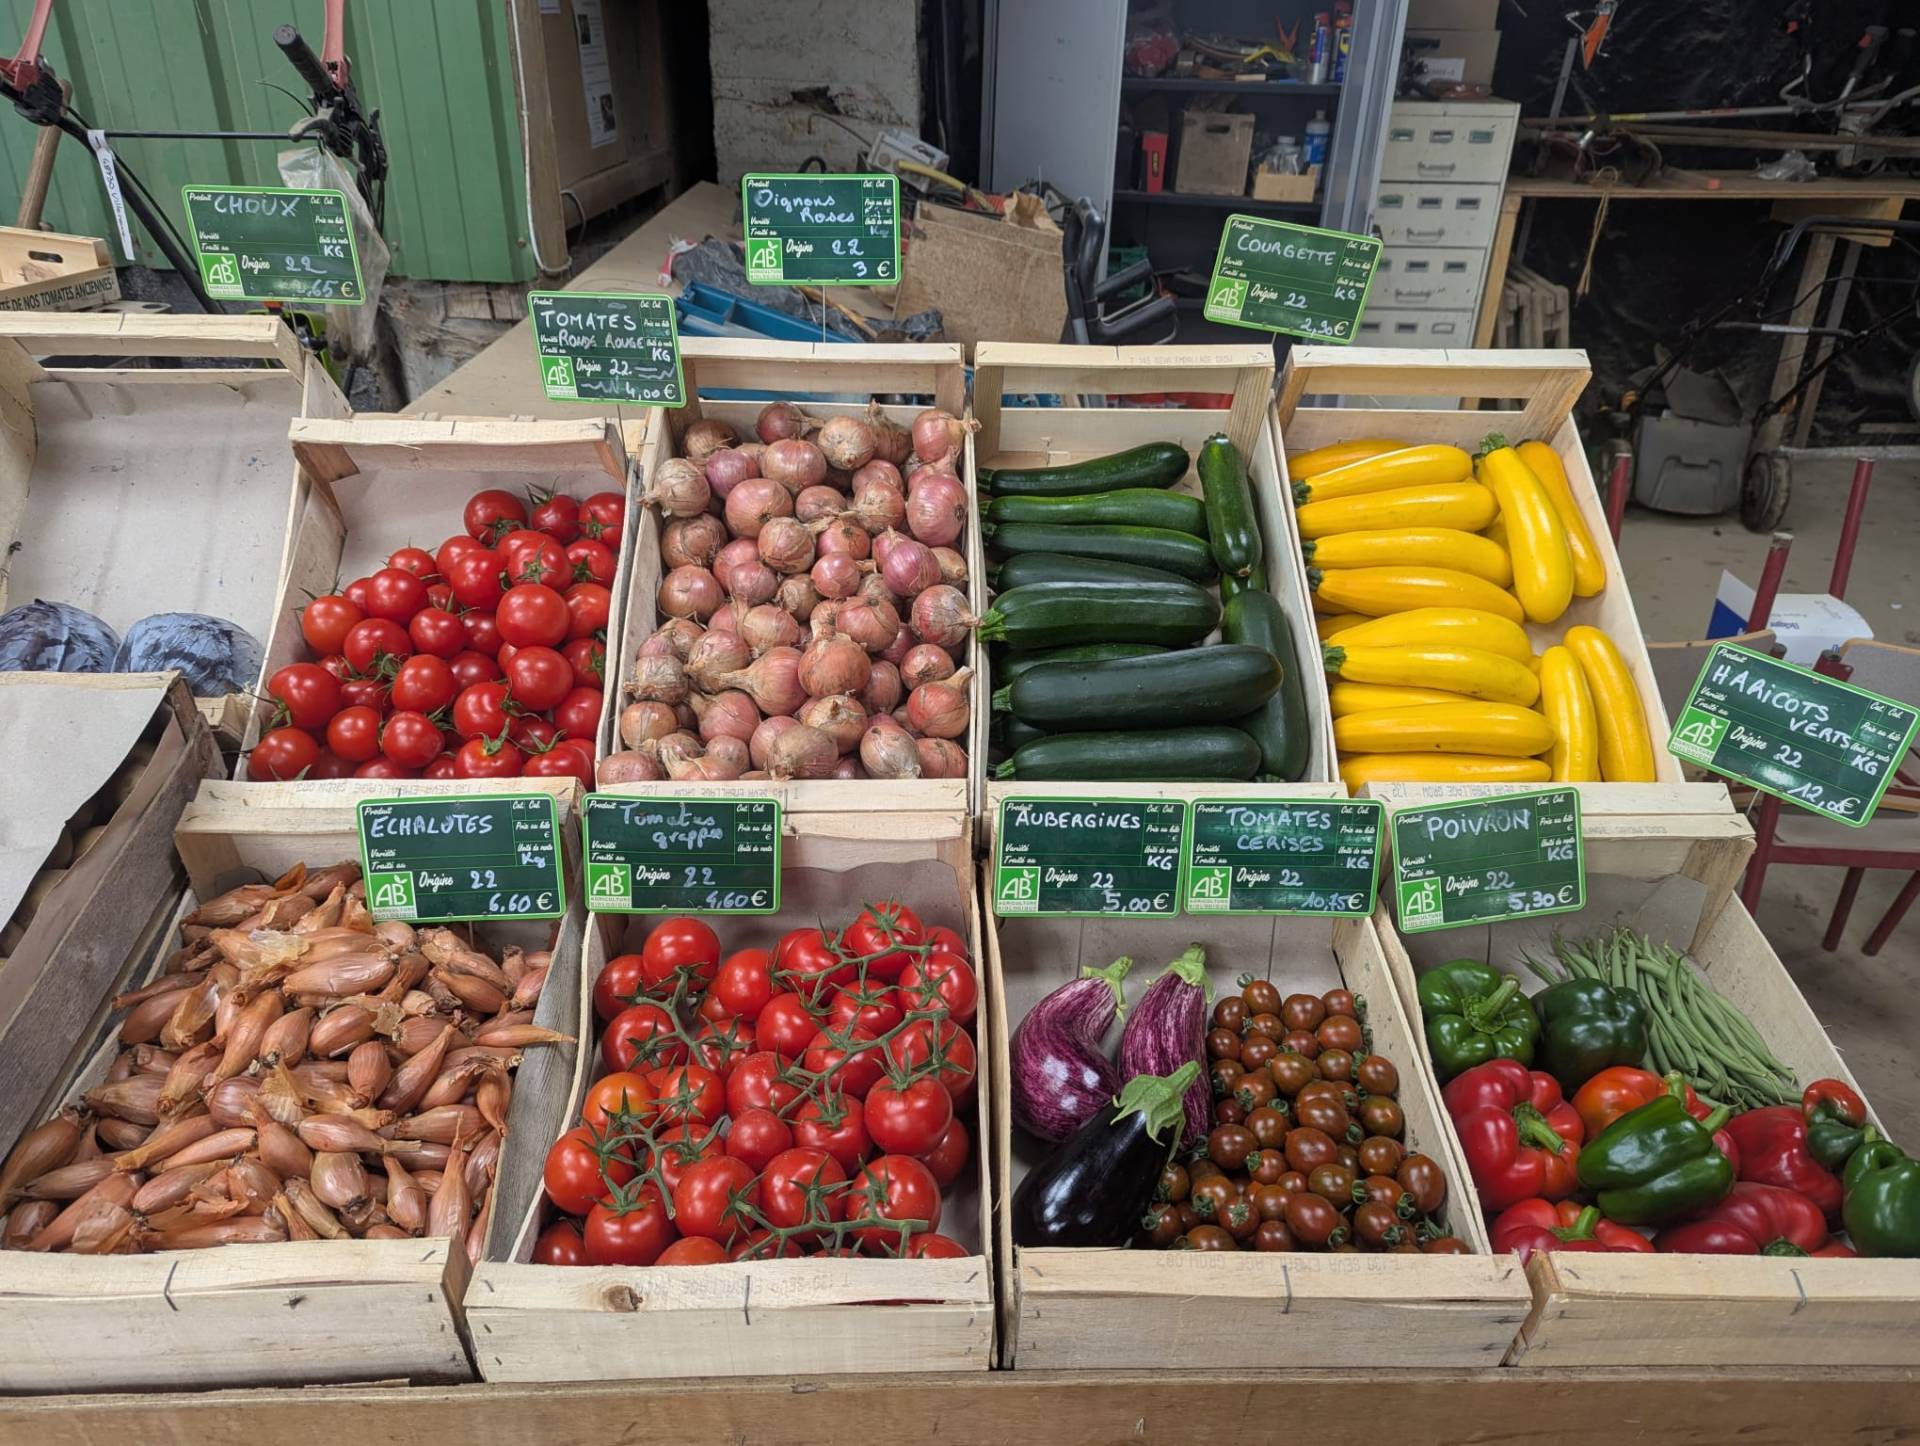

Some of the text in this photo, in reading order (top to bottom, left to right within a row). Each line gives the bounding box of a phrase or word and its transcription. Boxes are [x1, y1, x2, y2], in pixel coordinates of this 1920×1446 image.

[214, 195, 299, 217] CHOUX
[800, 208, 854, 223] Roses
[324, 245, 344, 257] KG
[786, 238, 864, 257] Origine 22
[1237, 234, 1336, 266] COURGETTE
[243, 255, 327, 274] Origine 22
[751, 247, 776, 268] AB
[209, 263, 231, 284] AB
[853, 260, 889, 277] 3 €
[23, 294, 40, 309] NOS
[40, 285, 75, 306] TOMATES
[75, 277, 113, 300] ANCIENNES
[340, 280, 353, 297] €
[1213, 288, 1239, 307] AB
[1251, 284, 1308, 308] Origine 22
[541, 311, 636, 331] TOMATES
[1333, 320, 1348, 335] €
[605, 333, 644, 349] ROUGE
[652, 349, 670, 362] KG
[547, 365, 567, 385] AB
[577, 357, 600, 377] Origine
[626, 382, 675, 400] 4,00 €
[1717, 649, 1747, 664] Produit
[1701, 687, 1727, 701] Variété
[1679, 722, 1714, 746] AB
[1790, 717, 1851, 749] VERTS
[1730, 726, 1802, 768] Origine 22
[1851, 755, 1879, 775] KG
[364, 806, 391, 816] Produit
[588, 801, 616, 809] Produit
[1006, 803, 1033, 811] Produit
[1196, 805, 1224, 813] Produit
[1838, 794, 1860, 814] €
[1226, 807, 1331, 829] TOMATES
[1397, 814, 1423, 825] Produit
[370, 848, 395, 857] Variété
[590, 840, 617, 848] Variété
[1004, 843, 1029, 851] Variété
[1195, 844, 1221, 852] Variété
[1147, 856, 1172, 870] KG
[1347, 857, 1369, 868] KG
[1401, 855, 1426, 866] Variété
[1548, 847, 1573, 861] KG
[419, 870, 497, 892] Origine 22
[592, 873, 624, 895] AB
[636, 865, 716, 887] Origine 22
[1044, 867, 1113, 888] Origine 22
[1236, 867, 1303, 887] Origine 22
[1446, 871, 1515, 897] Origine 22
[375, 882, 405, 906] AB
[1001, 877, 1032, 899] AB
[1191, 876, 1224, 897] AB
[489, 891, 552, 912] 6,60 €
[706, 889, 766, 908] 4,60 €
[1102, 890, 1169, 915] 5,00 €
[1346, 892, 1363, 909] €
[1405, 888, 1434, 915] AB
[1509, 884, 1572, 911] 5,30 €
